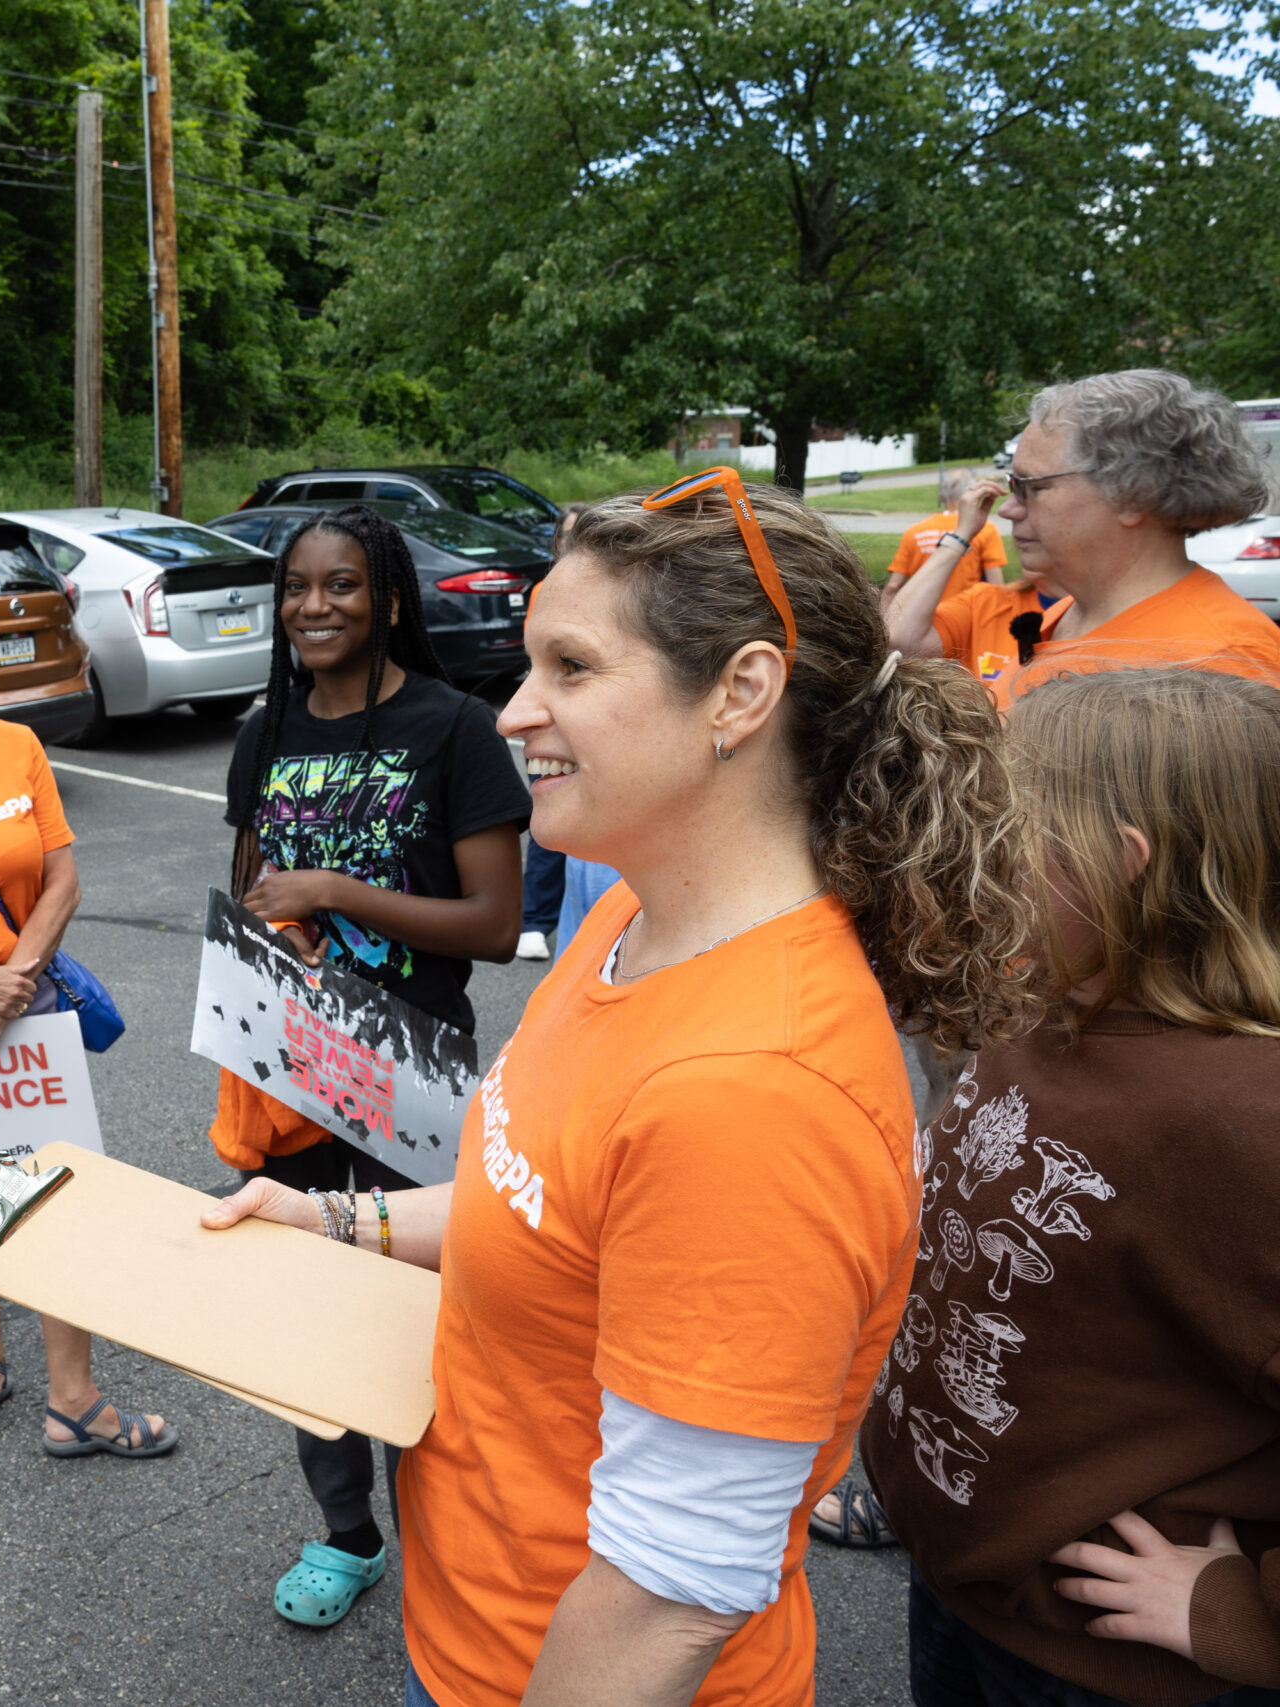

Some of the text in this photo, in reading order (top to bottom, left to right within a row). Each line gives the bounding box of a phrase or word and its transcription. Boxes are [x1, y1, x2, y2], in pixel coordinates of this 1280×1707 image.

[737, 498, 751, 521] goodr
[258, 749, 419, 824] KISS
[284, 1016, 394, 1101] FEWER
[285, 998, 394, 1074] FUNERALS
[287, 1043, 394, 1112] GRADUATIONS
[288, 1058, 394, 1142] MORE
